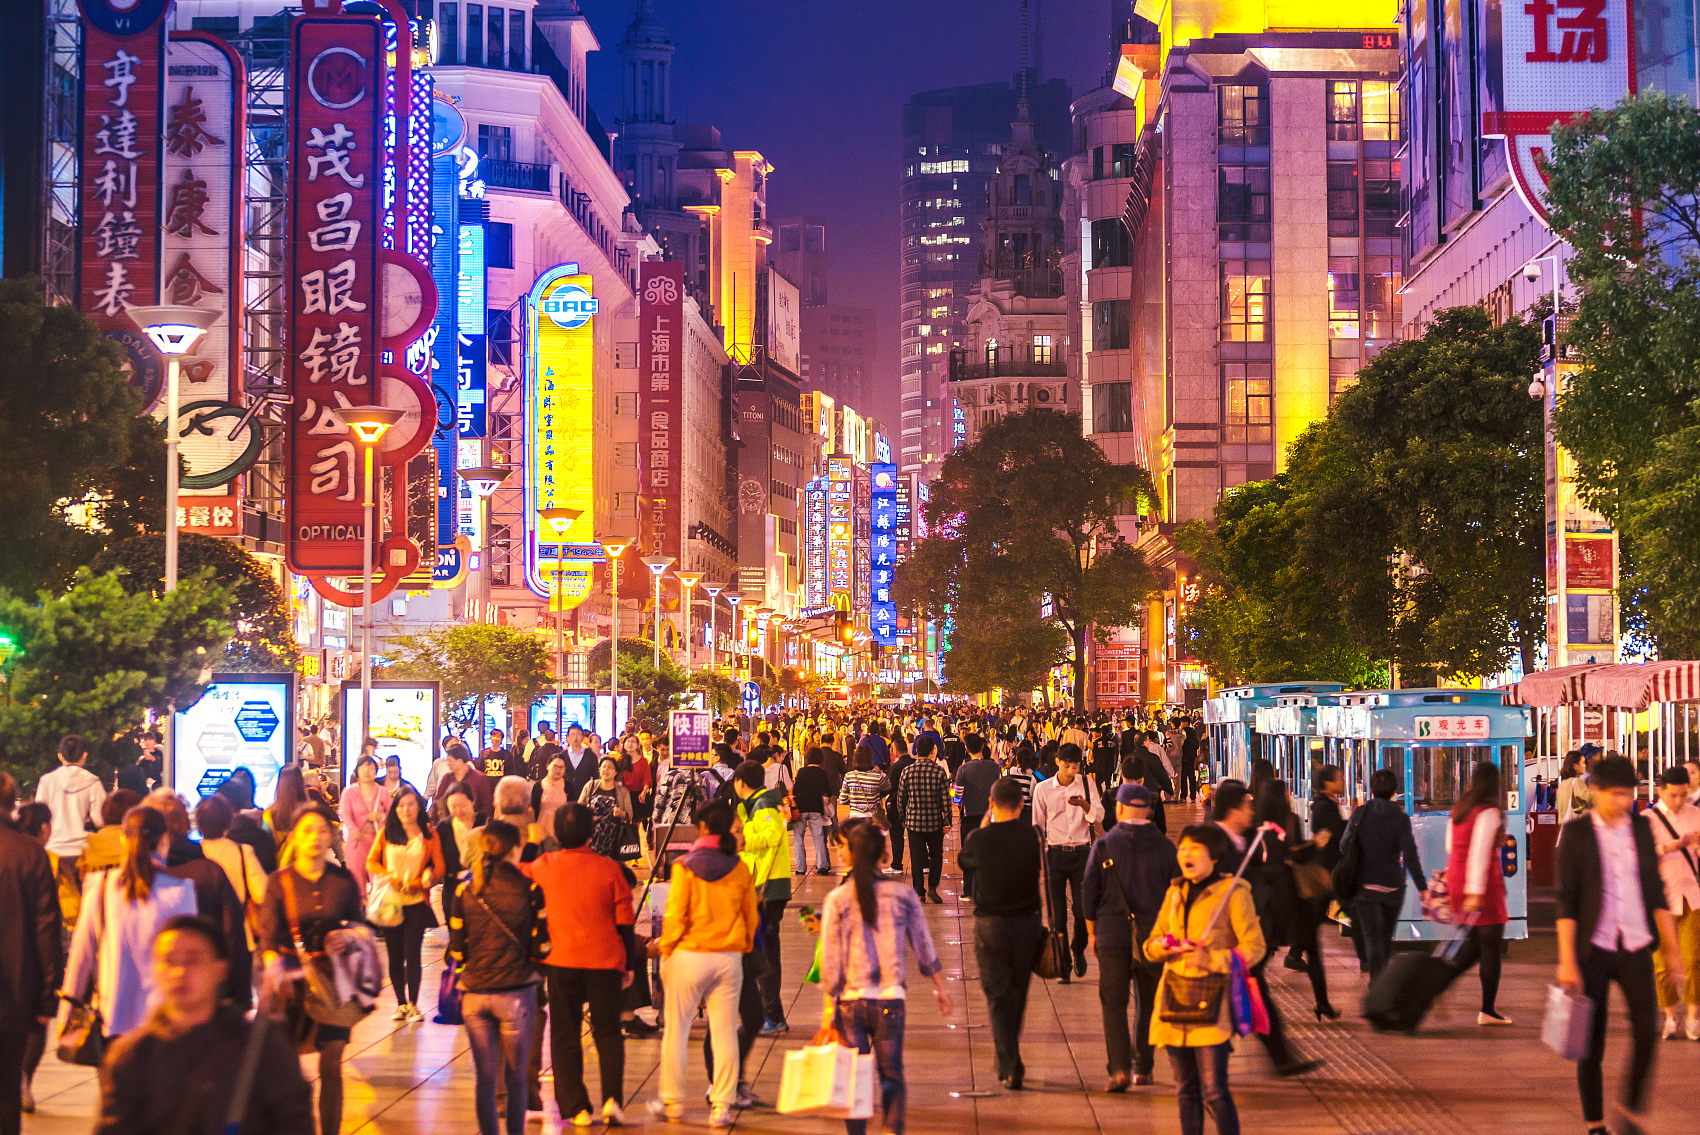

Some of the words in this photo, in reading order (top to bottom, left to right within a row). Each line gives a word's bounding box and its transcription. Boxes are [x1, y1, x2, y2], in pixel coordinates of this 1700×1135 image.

[544, 301, 597, 313] BAC
[651, 315, 670, 487] 上海市第一食品商店
[742, 411, 764, 420] TITONI
[835, 549, 849, 588] 真丝大王
[674, 714, 710, 736] 快照
[1438, 719, 1484, 730] 观光车
[1511, 794, 1516, 808] 2
